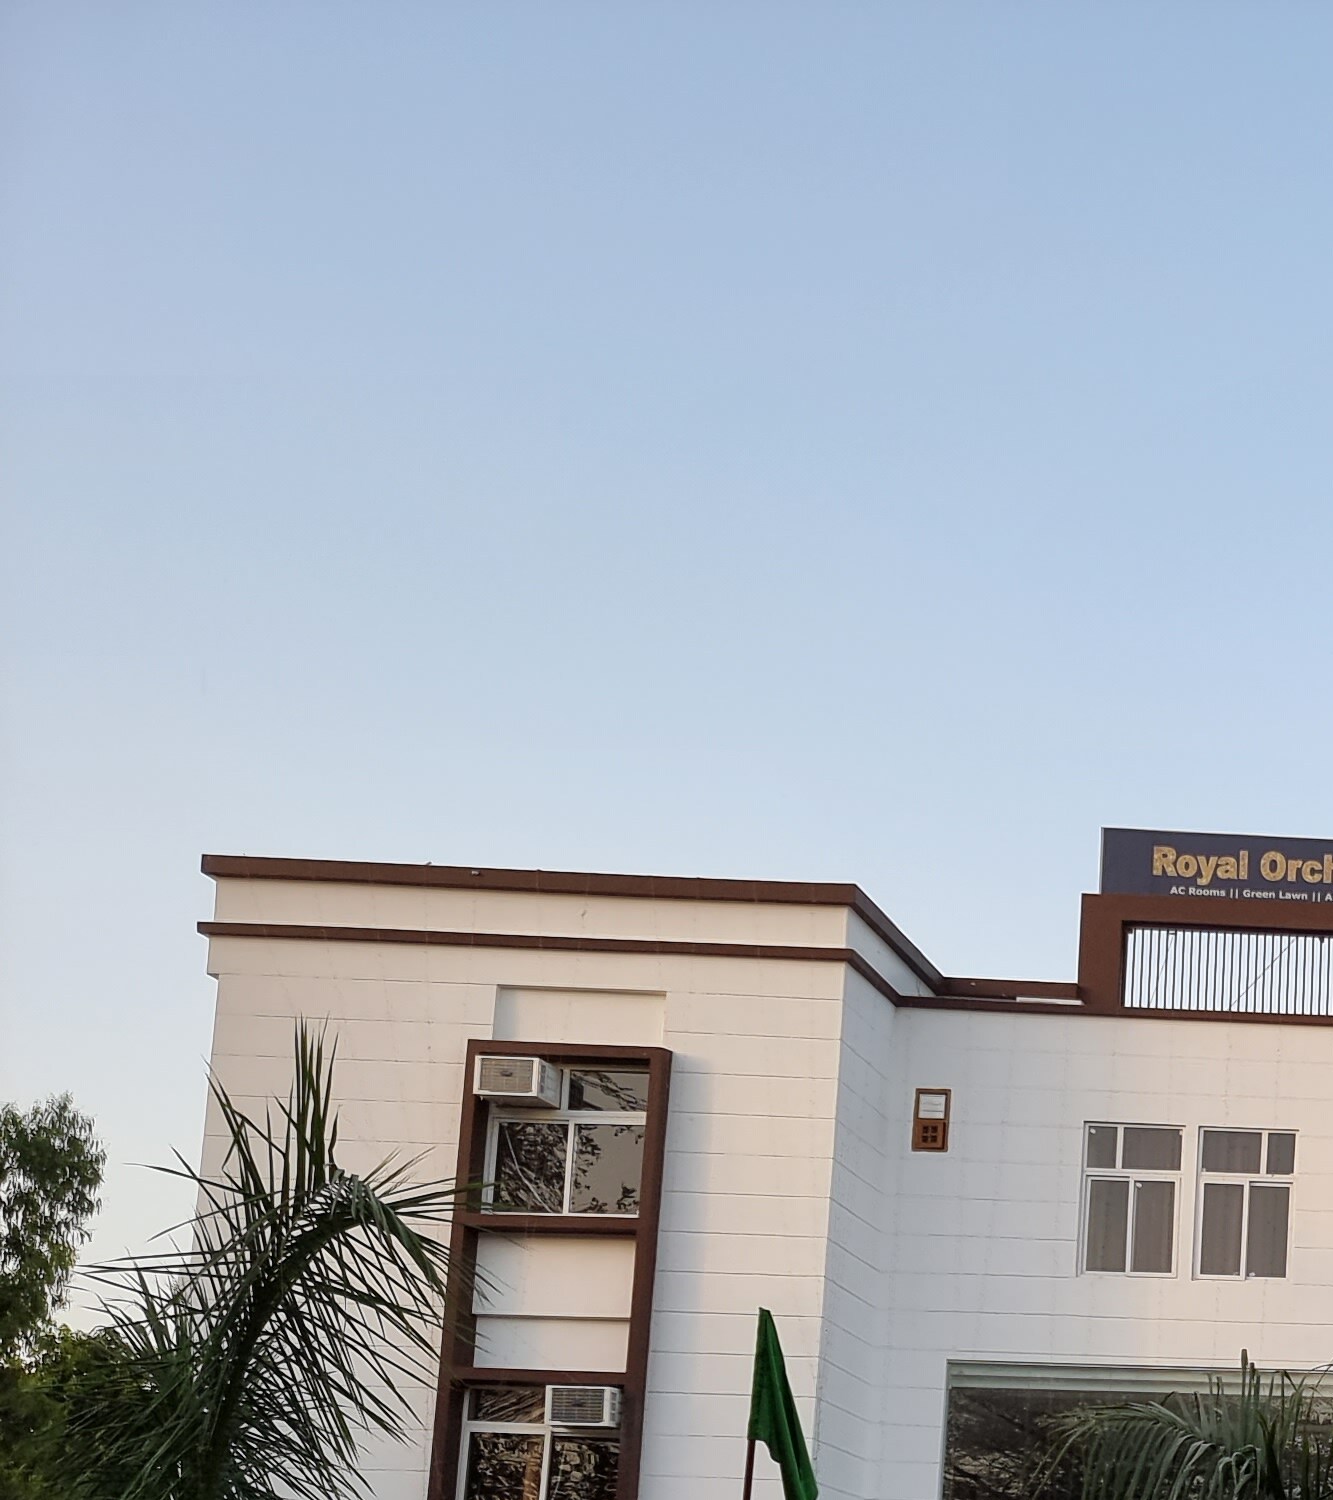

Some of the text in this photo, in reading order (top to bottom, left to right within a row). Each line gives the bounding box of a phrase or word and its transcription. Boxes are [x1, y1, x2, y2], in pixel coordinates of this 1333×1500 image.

[1152, 845, 1249, 886] Royal
[1170, 886, 1186, 895] AC
[1188, 887, 1226, 897] Rooms
[1243, 889, 1276, 899] Green
[1279, 890, 1308, 900] Lawn
